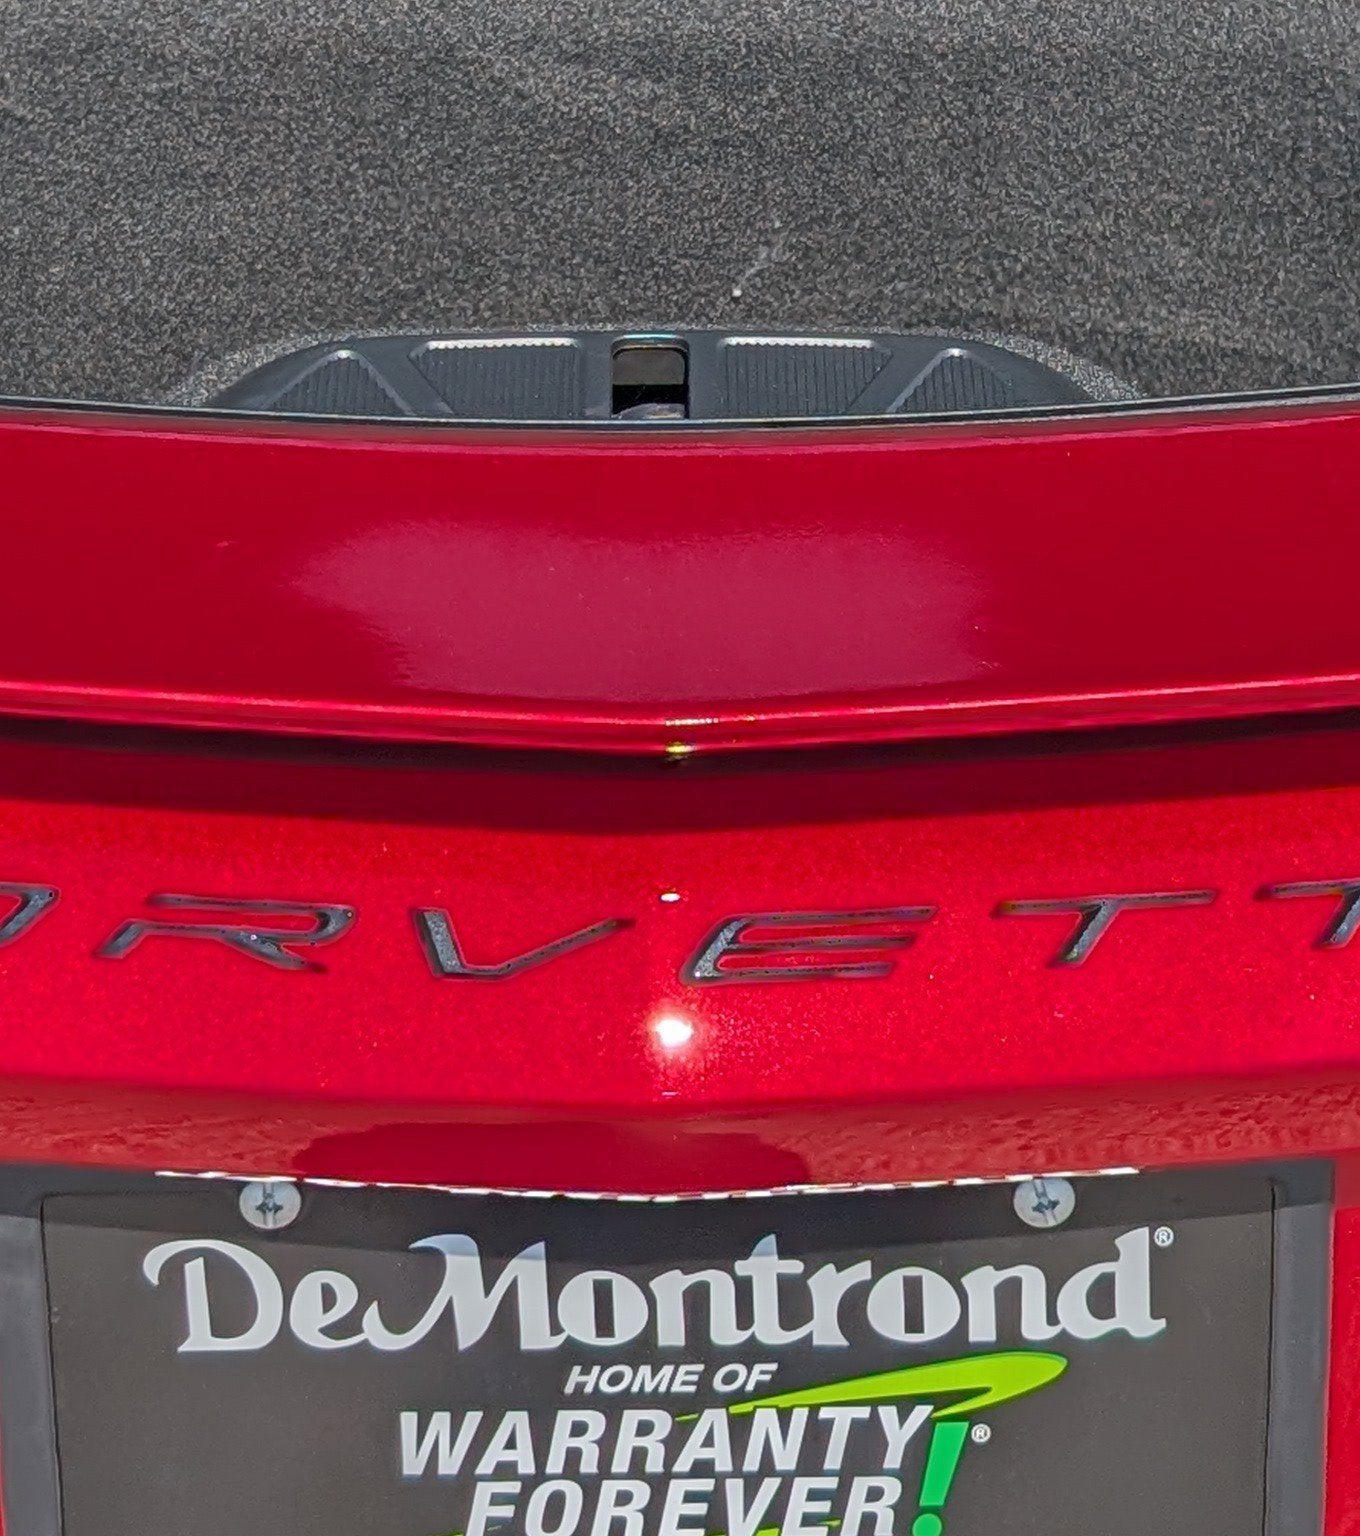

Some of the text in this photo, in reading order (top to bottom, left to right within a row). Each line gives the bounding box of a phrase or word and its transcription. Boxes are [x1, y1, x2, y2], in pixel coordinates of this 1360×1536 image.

[563, 1362, 779, 1395] HOME OF
[397, 1405, 934, 1476] WARRANTY
